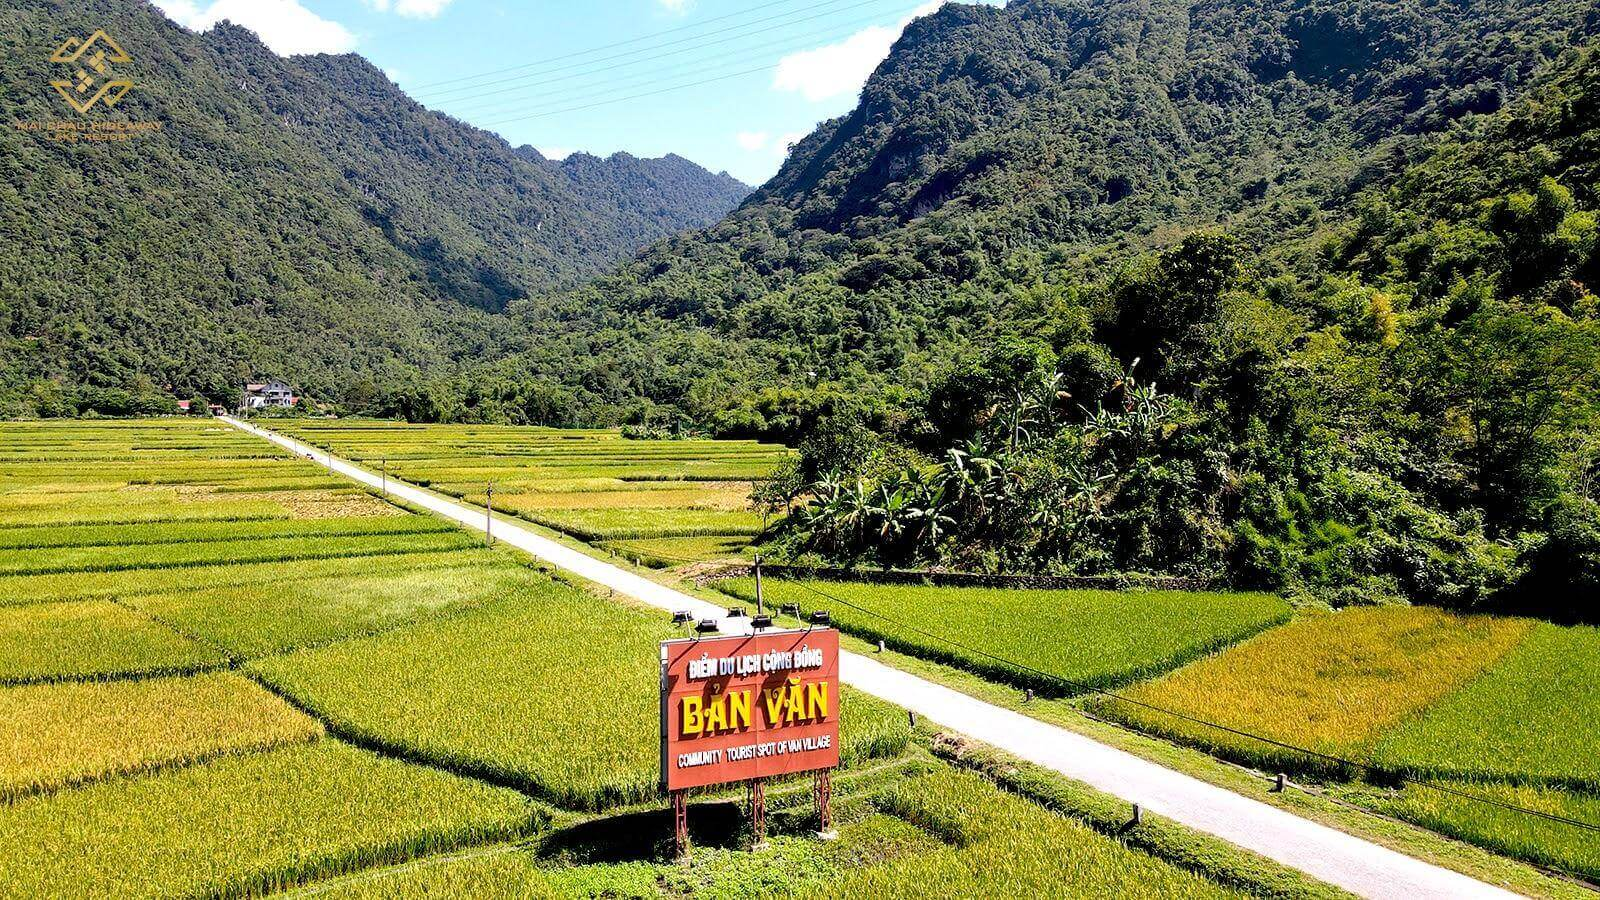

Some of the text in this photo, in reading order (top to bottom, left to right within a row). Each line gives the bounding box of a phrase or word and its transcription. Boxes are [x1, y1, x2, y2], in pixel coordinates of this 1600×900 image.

[689, 645, 822, 678] ĐIỂM DU LỊCH CỘNG ĐỒNG
[682, 676, 829, 734] BẢN VĂN
[678, 735, 831, 768] COMMUNITY TOURIST SPOT OF VAN VILLAGE
